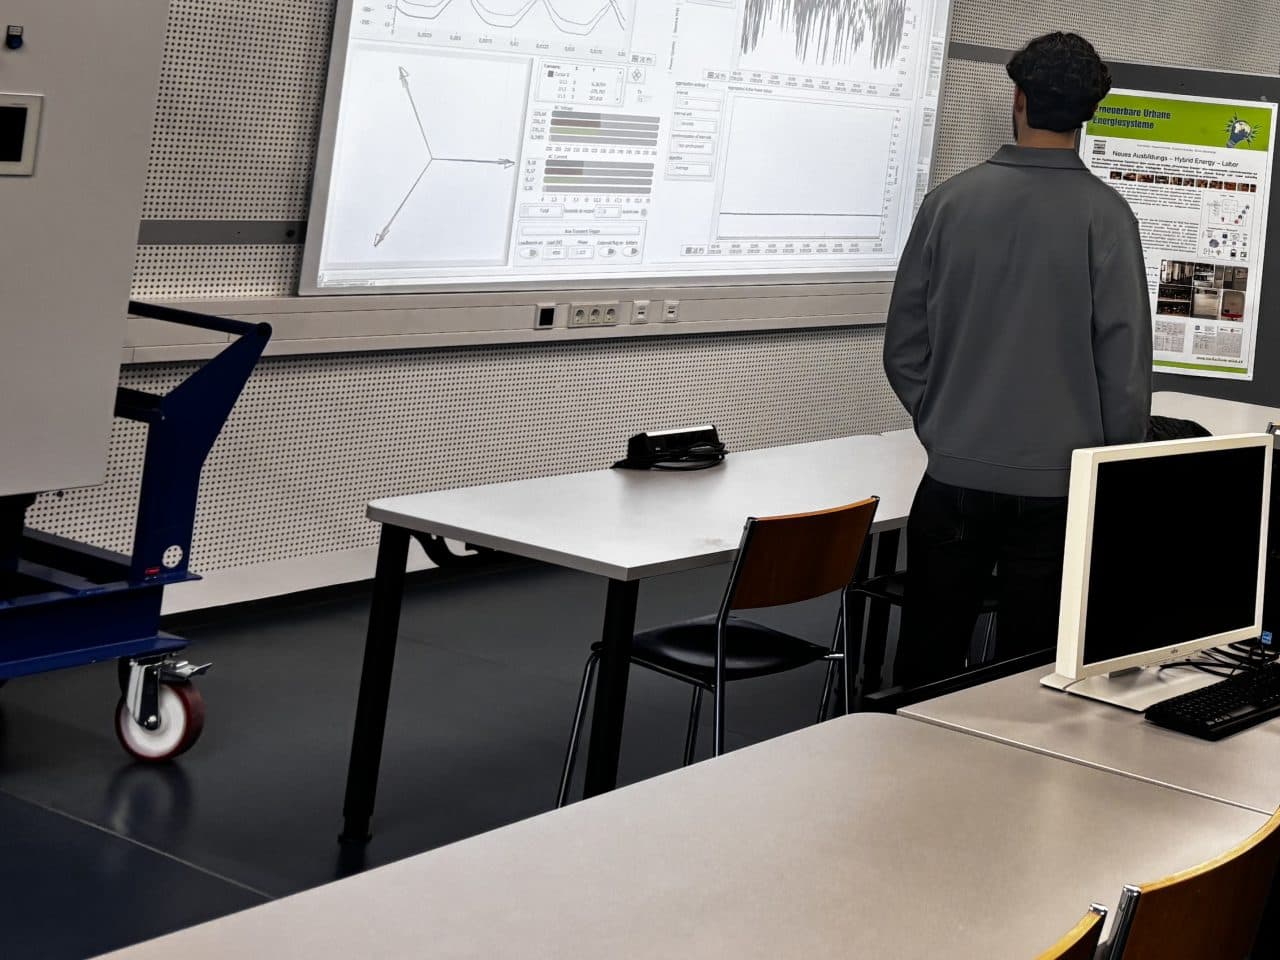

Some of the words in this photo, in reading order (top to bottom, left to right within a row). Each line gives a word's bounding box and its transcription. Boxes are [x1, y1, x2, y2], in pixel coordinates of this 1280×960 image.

[1097, 105, 1142, 117] rneuerbare
[1143, 108, 1171, 120] Urbane
[1131, 152, 1168, 163] Ausbildungs
[1174, 156, 1193, 166] Hybrid
[1194, 158, 1215, 169] Energy
